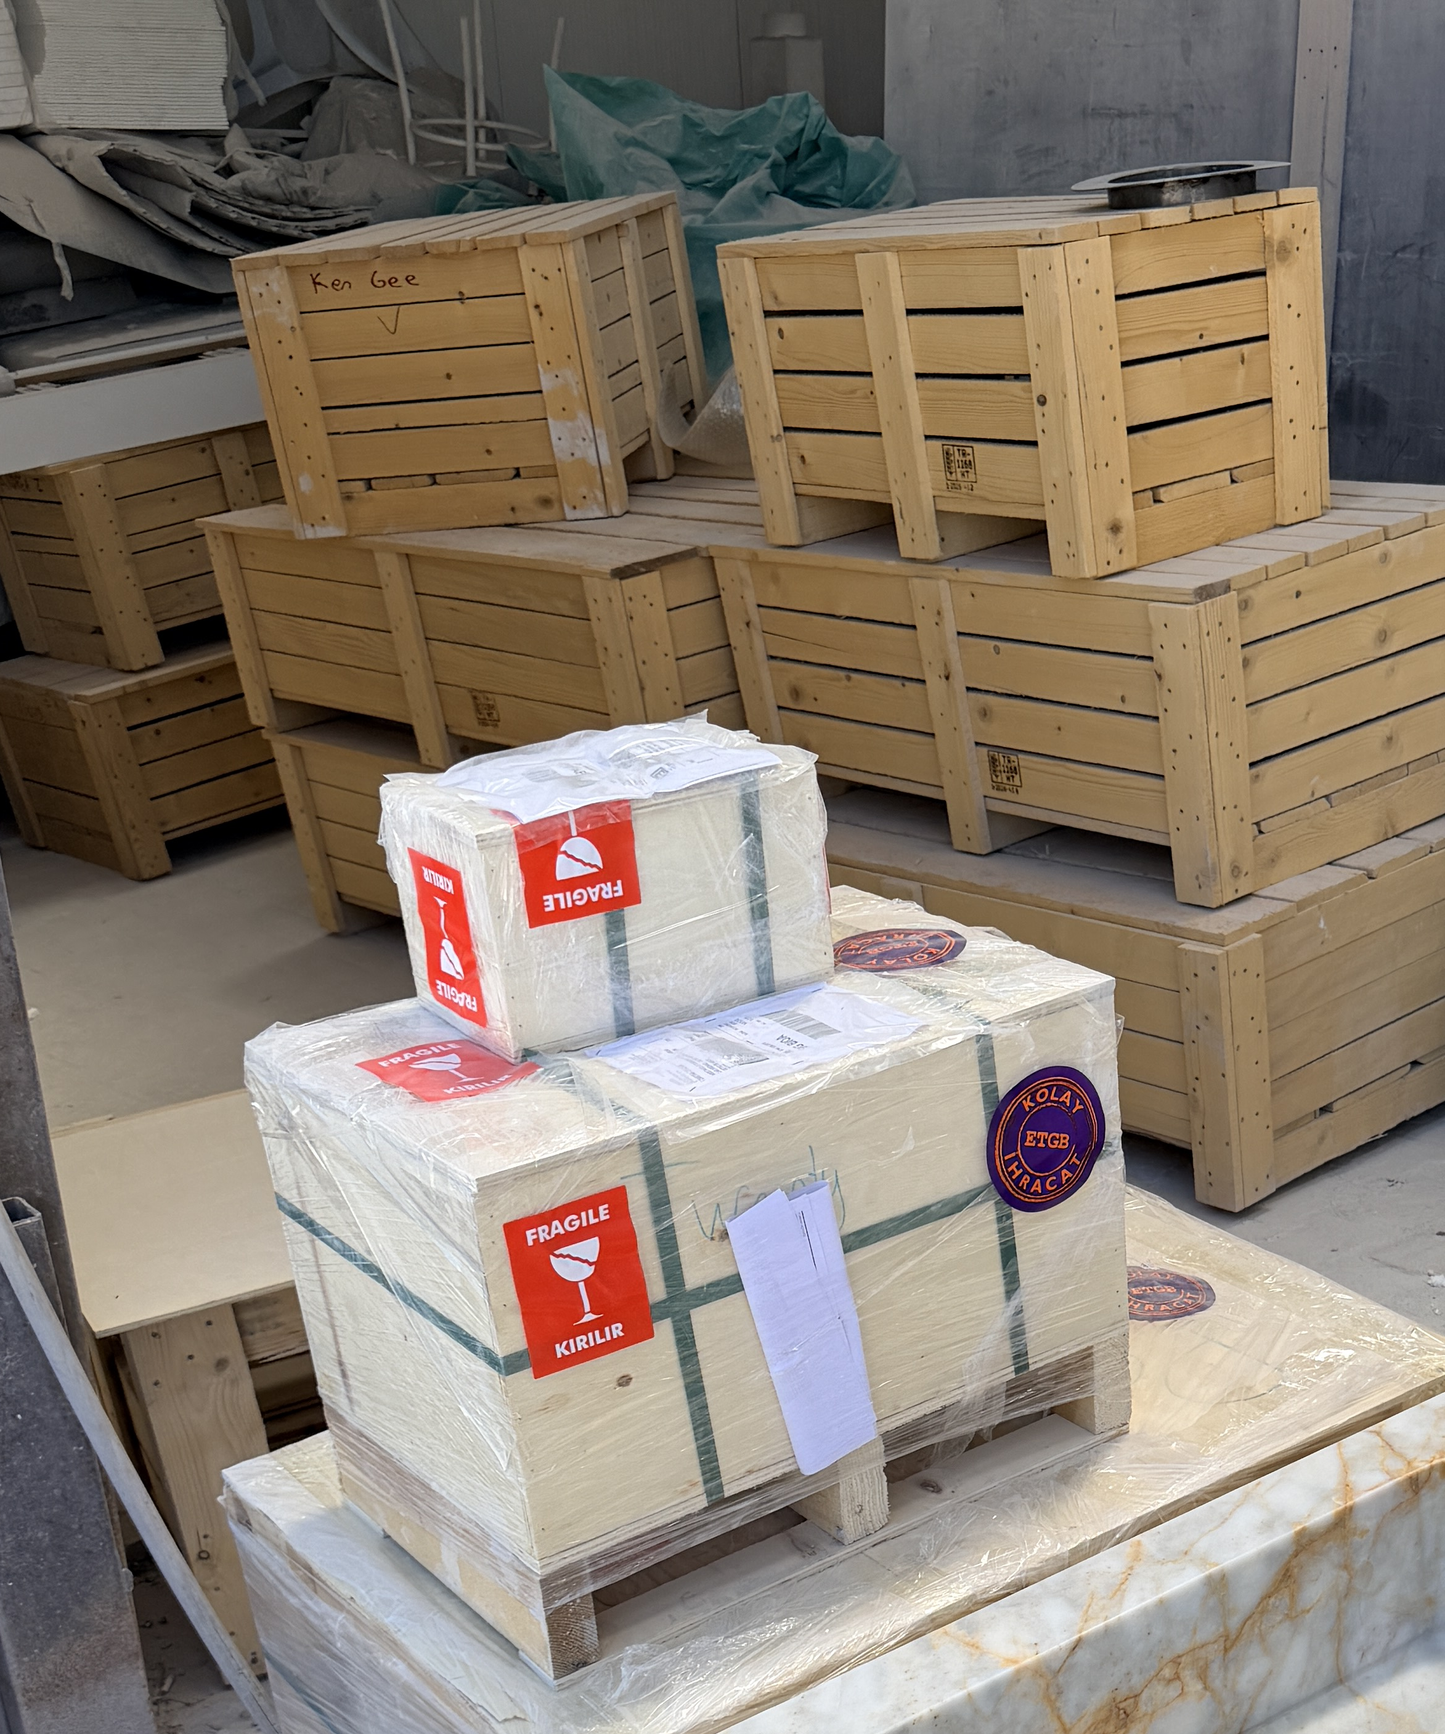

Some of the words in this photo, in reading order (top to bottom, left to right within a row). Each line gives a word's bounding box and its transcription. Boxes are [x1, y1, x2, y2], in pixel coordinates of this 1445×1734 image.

[421, 866, 455, 895] KIRILIR
[543, 879, 624, 913] FRAGILE
[435, 979, 478, 1012] FRAGILE
[378, 1042, 462, 1068] FRAGILE
[443, 1073, 513, 1095] KIRILIR
[1021, 1086, 1084, 1114] KOLAY
[1024, 1130, 1070, 1149] ETGB
[525, 1203, 611, 1247] FRAGILE
[1128, 1292, 1200, 1311] HRACAT
[554, 1322, 625, 1359] KIRILIR
